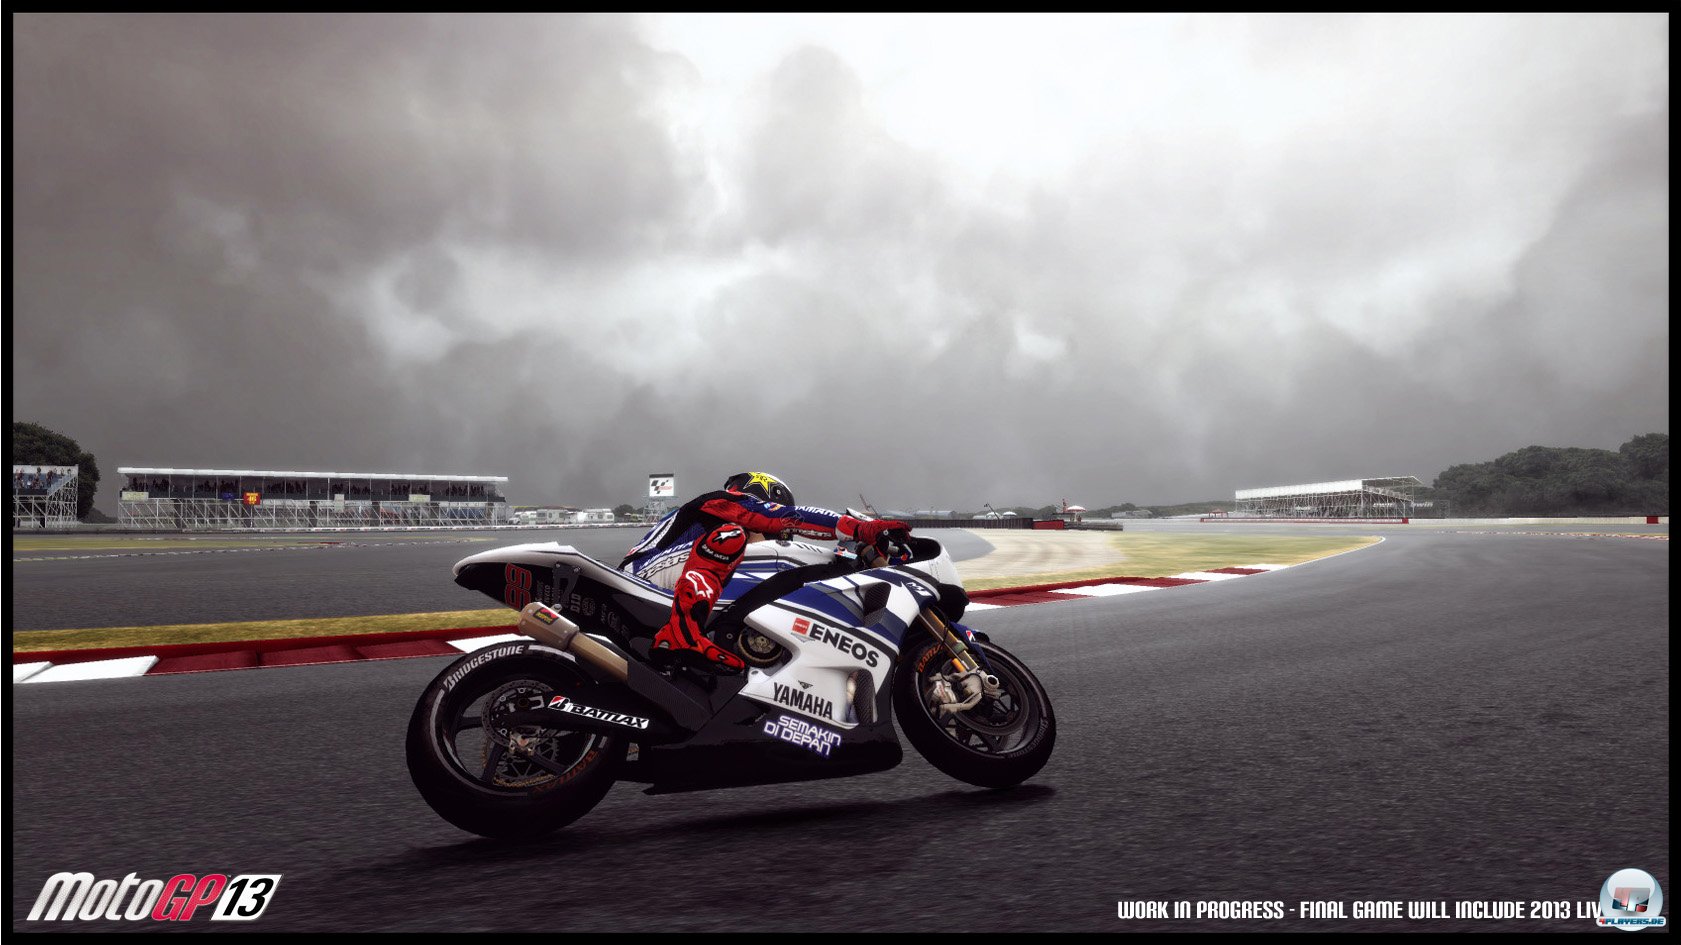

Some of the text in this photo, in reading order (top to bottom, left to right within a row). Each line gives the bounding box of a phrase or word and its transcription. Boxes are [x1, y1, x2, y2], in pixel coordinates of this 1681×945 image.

[809, 623, 880, 668] ENEOS
[443, 645, 525, 692] BRIDGESTONE
[569, 704, 649, 729] BATTLAX
[773, 682, 833, 720] YAMAHA
[764, 721, 832, 756] DI DEPAN
[778, 715, 842, 746] SEMAKIN
